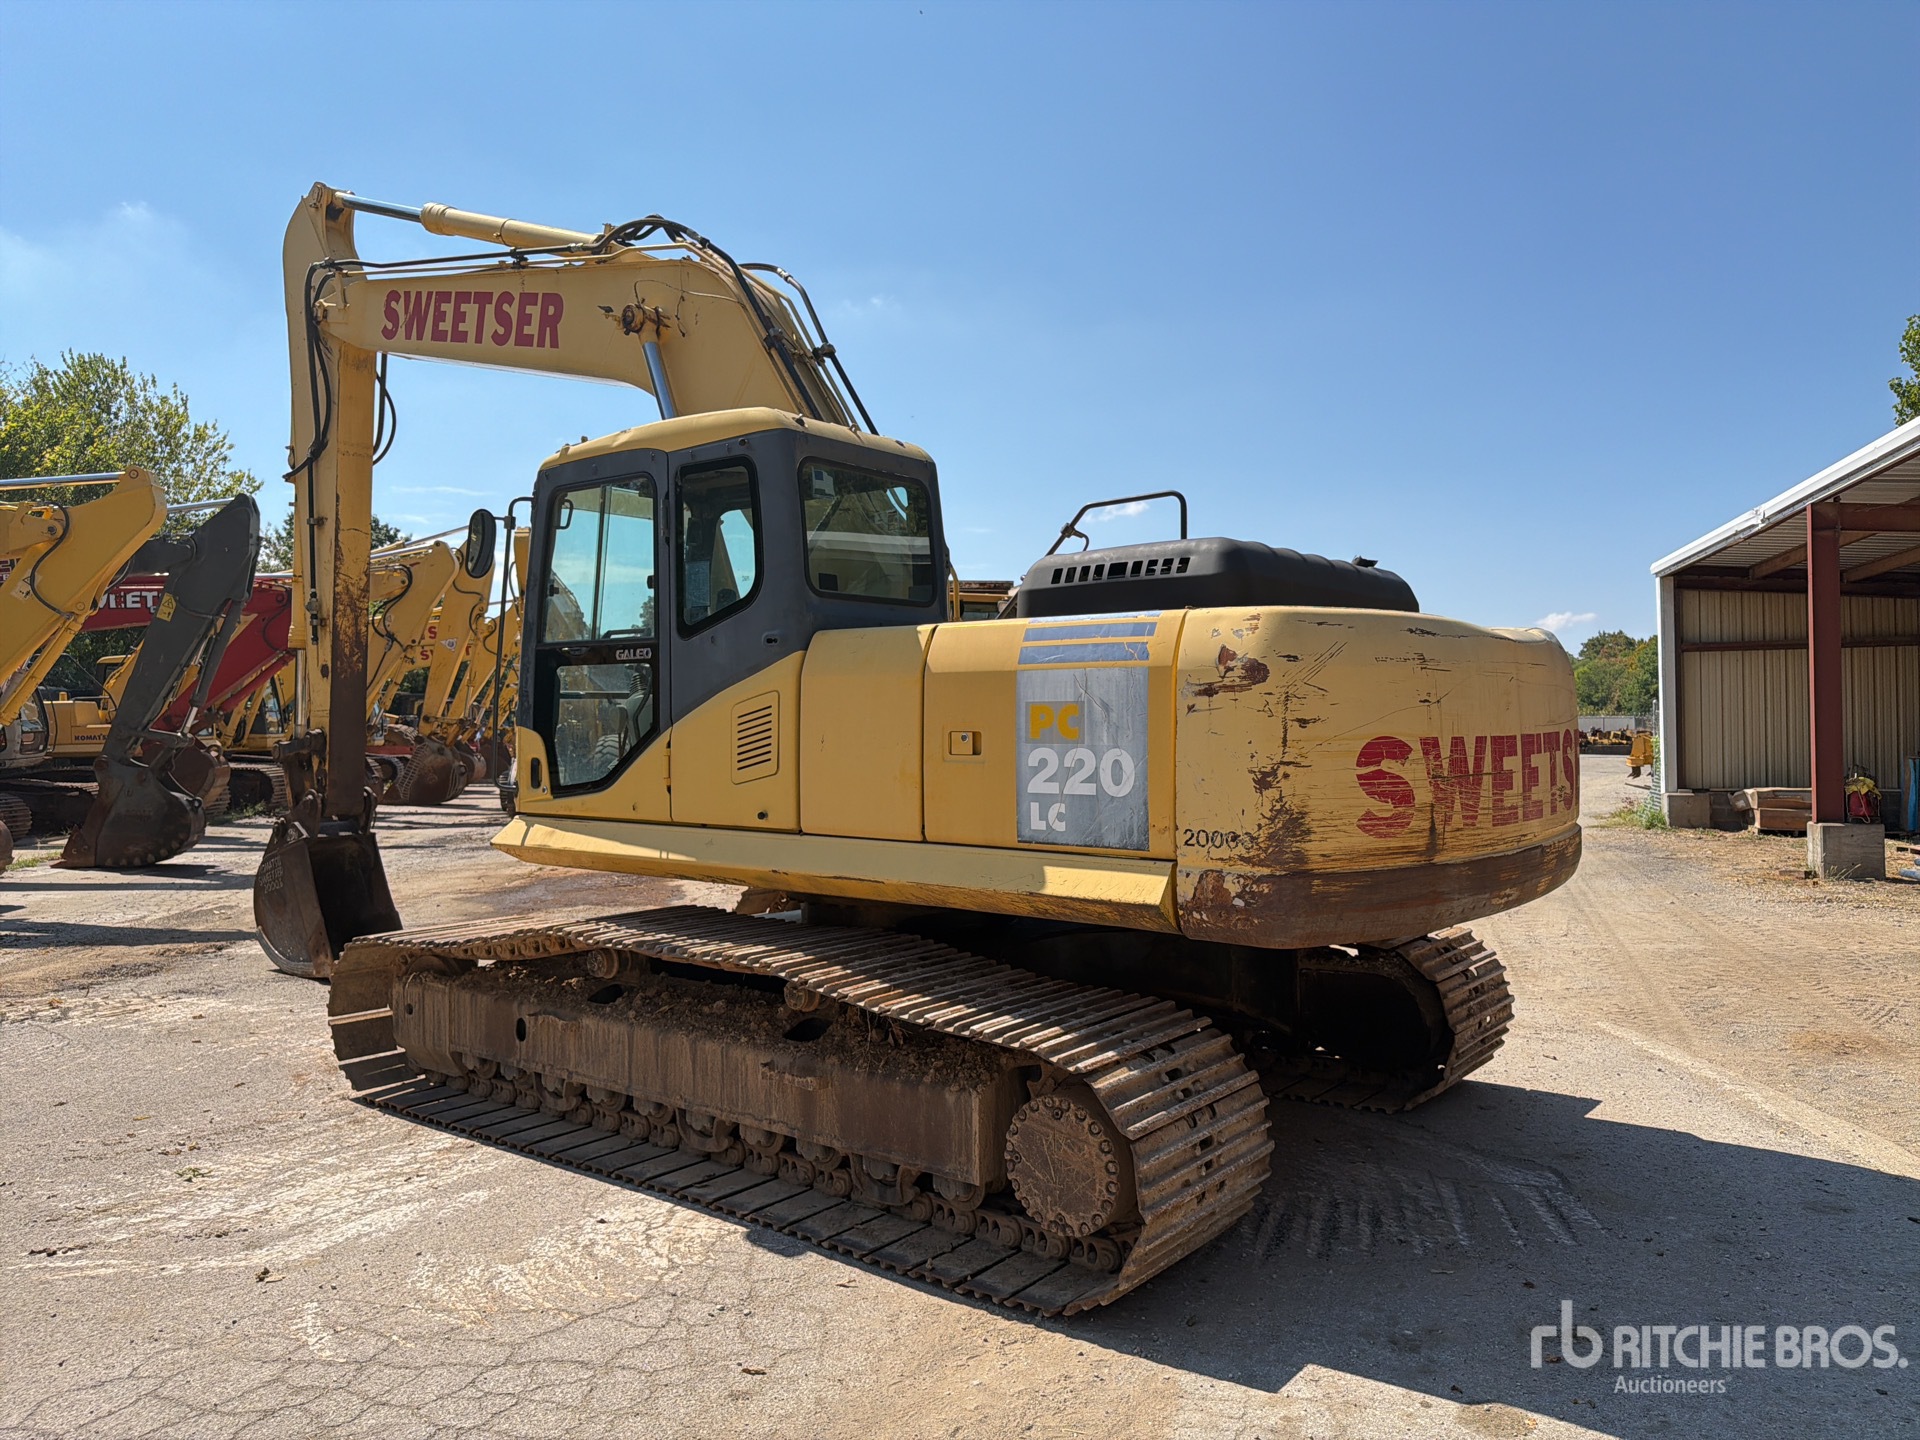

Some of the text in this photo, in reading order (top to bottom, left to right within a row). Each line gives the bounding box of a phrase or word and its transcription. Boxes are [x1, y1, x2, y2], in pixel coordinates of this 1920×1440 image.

[381, 289, 564, 349] SWEETSER
[616, 648, 652, 660] GALEO
[74, 733, 108, 741] KOMATS
[1030, 703, 1079, 741] PC
[1027, 746, 1136, 798] 220
[1356, 728, 1580, 839] SWEETS
[1030, 802, 1066, 832] LC
